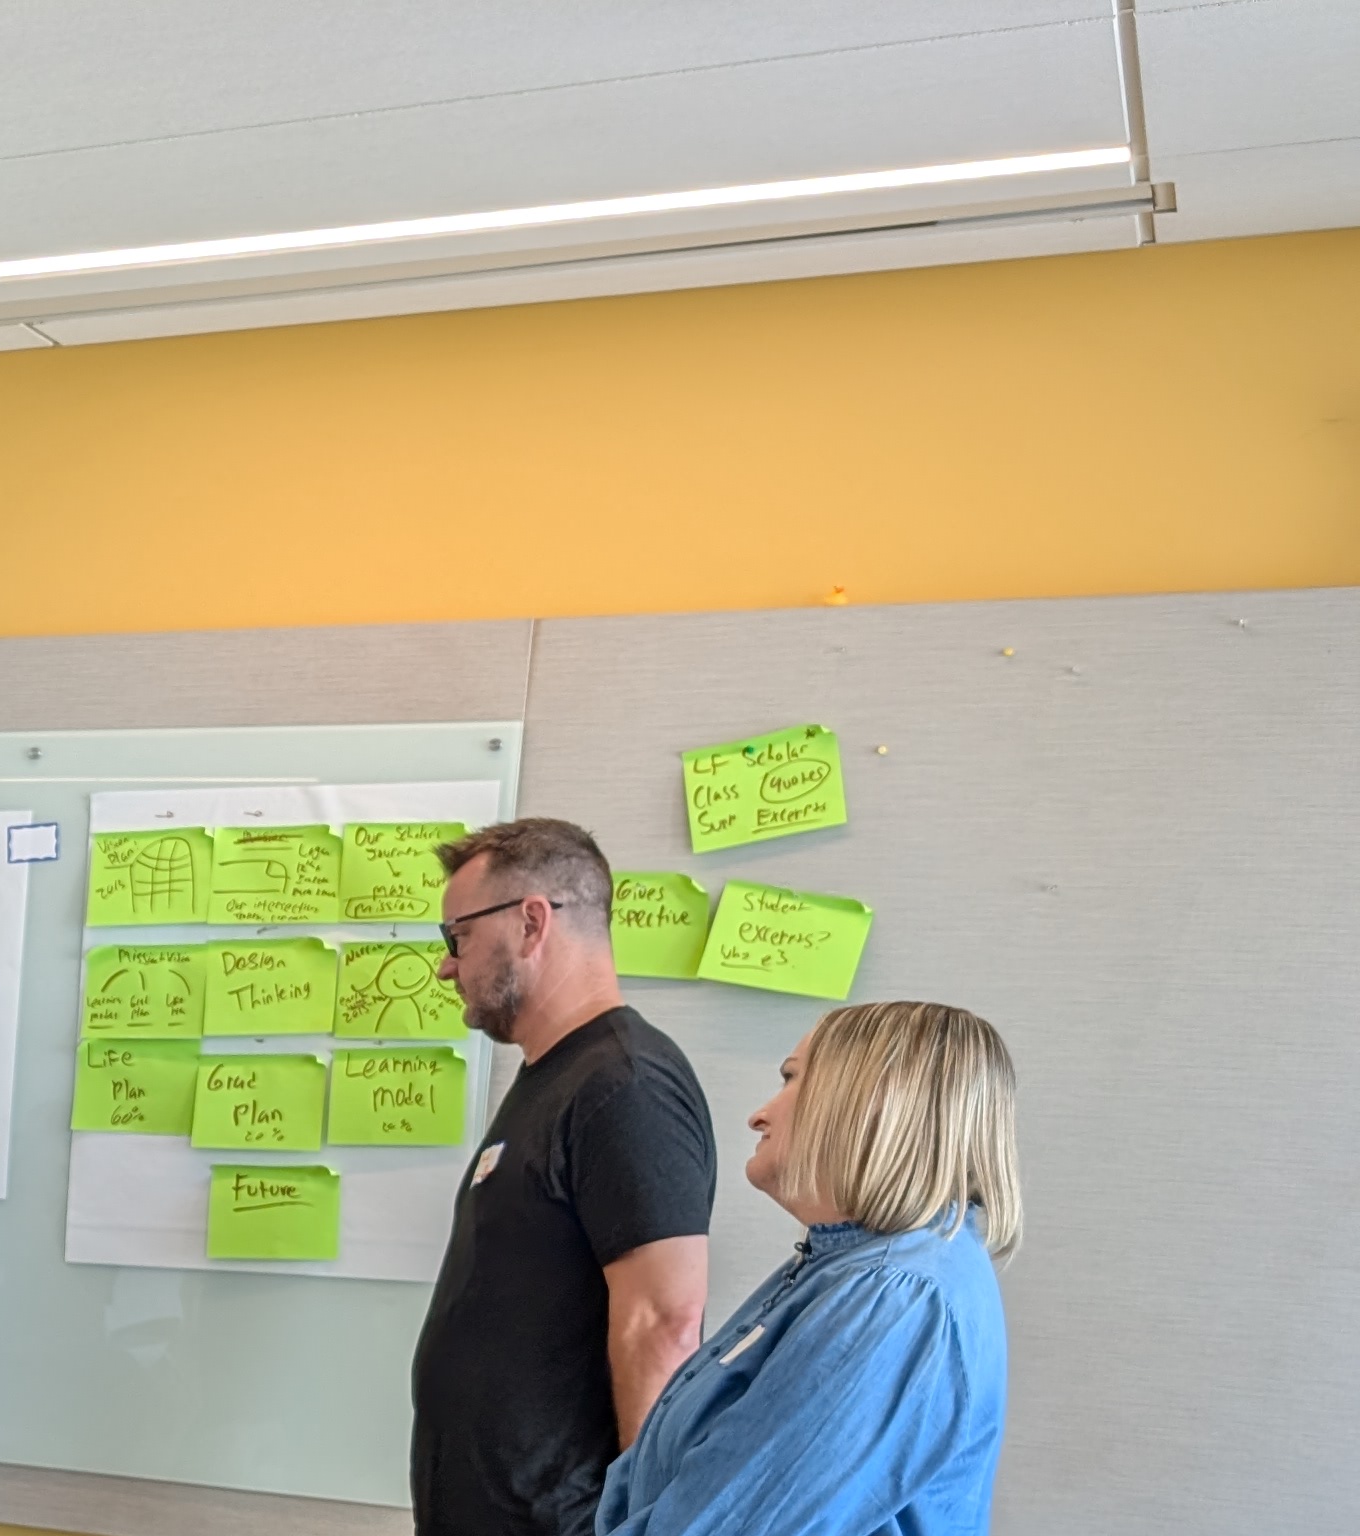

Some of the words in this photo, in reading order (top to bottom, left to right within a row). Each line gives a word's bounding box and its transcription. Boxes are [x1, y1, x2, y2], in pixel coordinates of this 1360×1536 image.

[741, 742, 809, 767] Scholar
[693, 785, 739, 809] Class
[610, 905, 691, 928] rspective
[222, 951, 286, 977] Design
[228, 981, 311, 1011] Thinking
[88, 1043, 134, 1068] Life
[346, 1052, 443, 1078] Learning
[111, 1079, 146, 1101] Plan
[207, 1064, 256, 1091] Grad
[373, 1082, 436, 1114] model
[233, 1100, 283, 1126] Plan
[232, 1174, 300, 1200] Future
